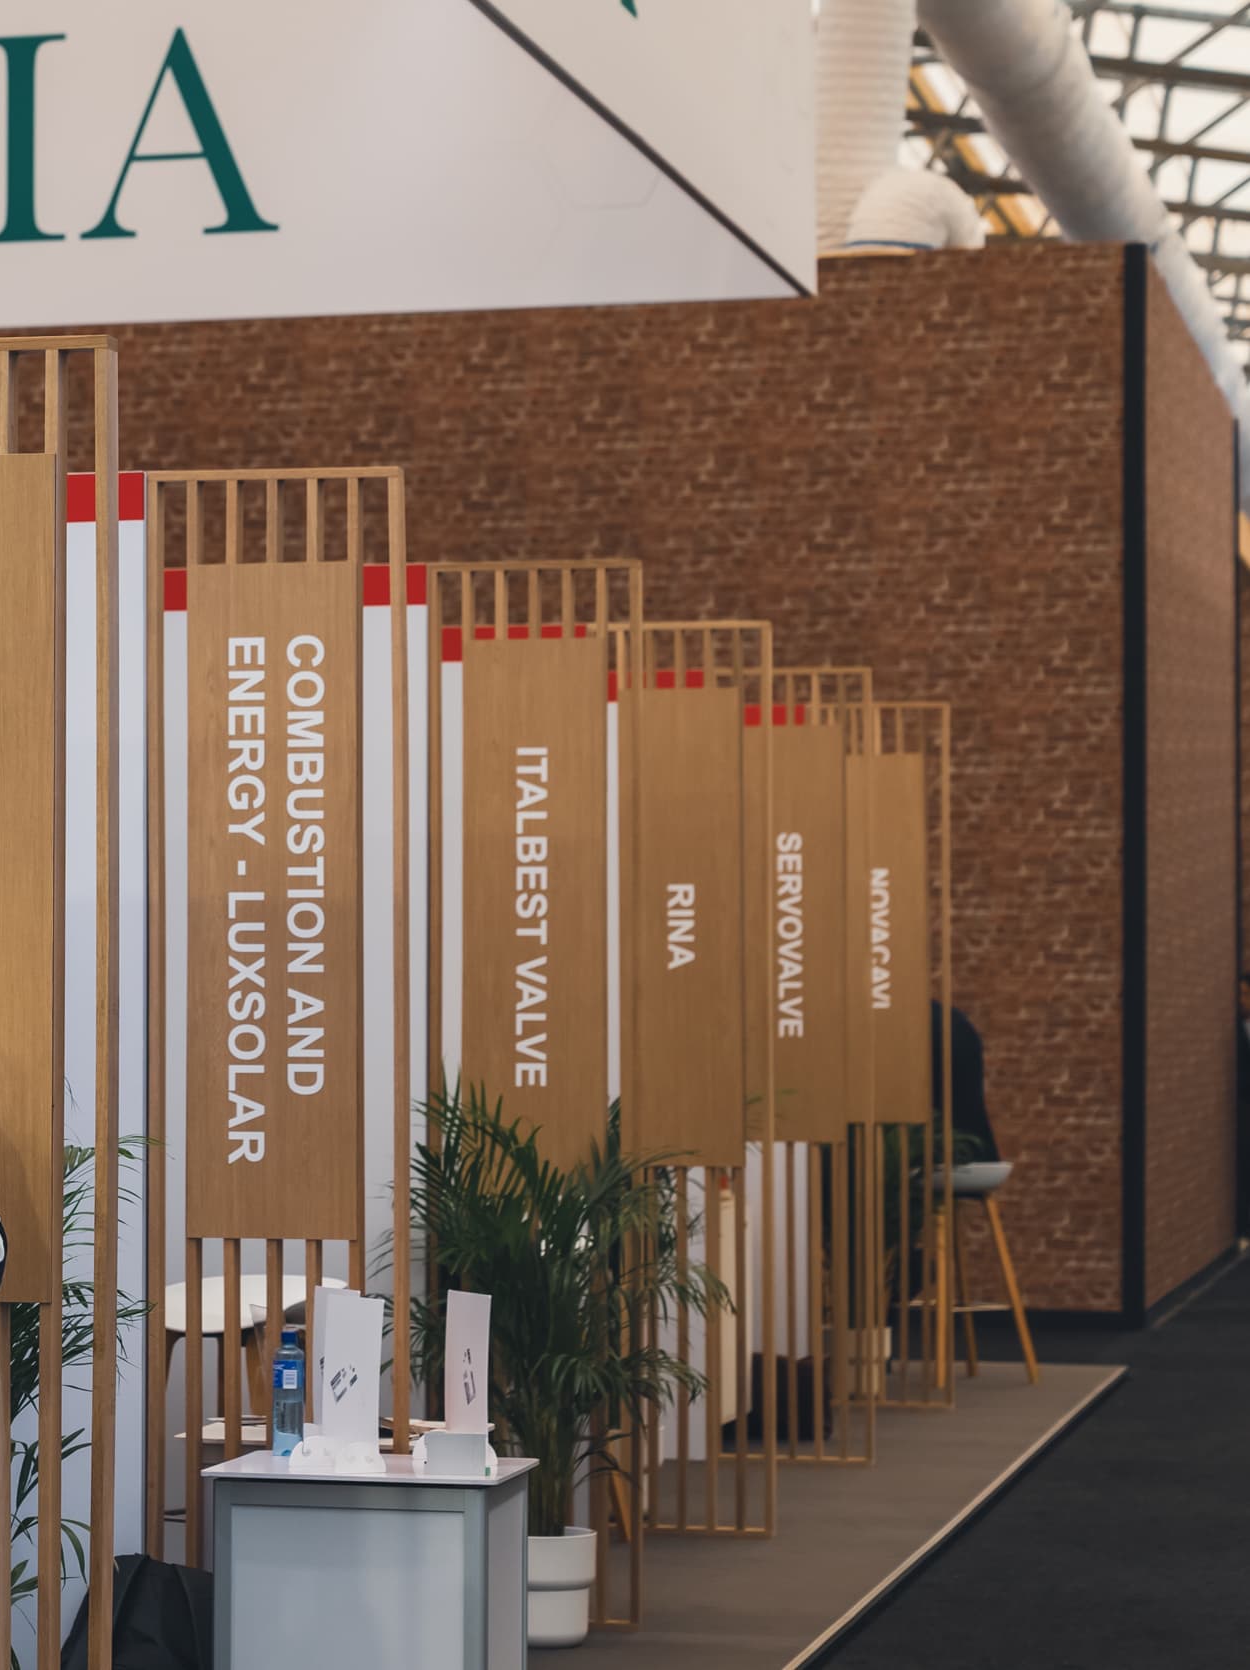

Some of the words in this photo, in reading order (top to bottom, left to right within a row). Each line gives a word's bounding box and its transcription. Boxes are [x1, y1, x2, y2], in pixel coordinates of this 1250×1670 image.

[227, 636, 266, 845] ENERGY
[286, 634, 325, 974] COMBUSTION
[515, 747, 548, 945] ITALBEST
[667, 883, 696, 970] RINA
[776, 832, 804, 1038] SERVOVALVE
[227, 891, 266, 1165] LUXSOLAR
[286, 988, 325, 1095] AND
[515, 956, 548, 1088] VALVE
